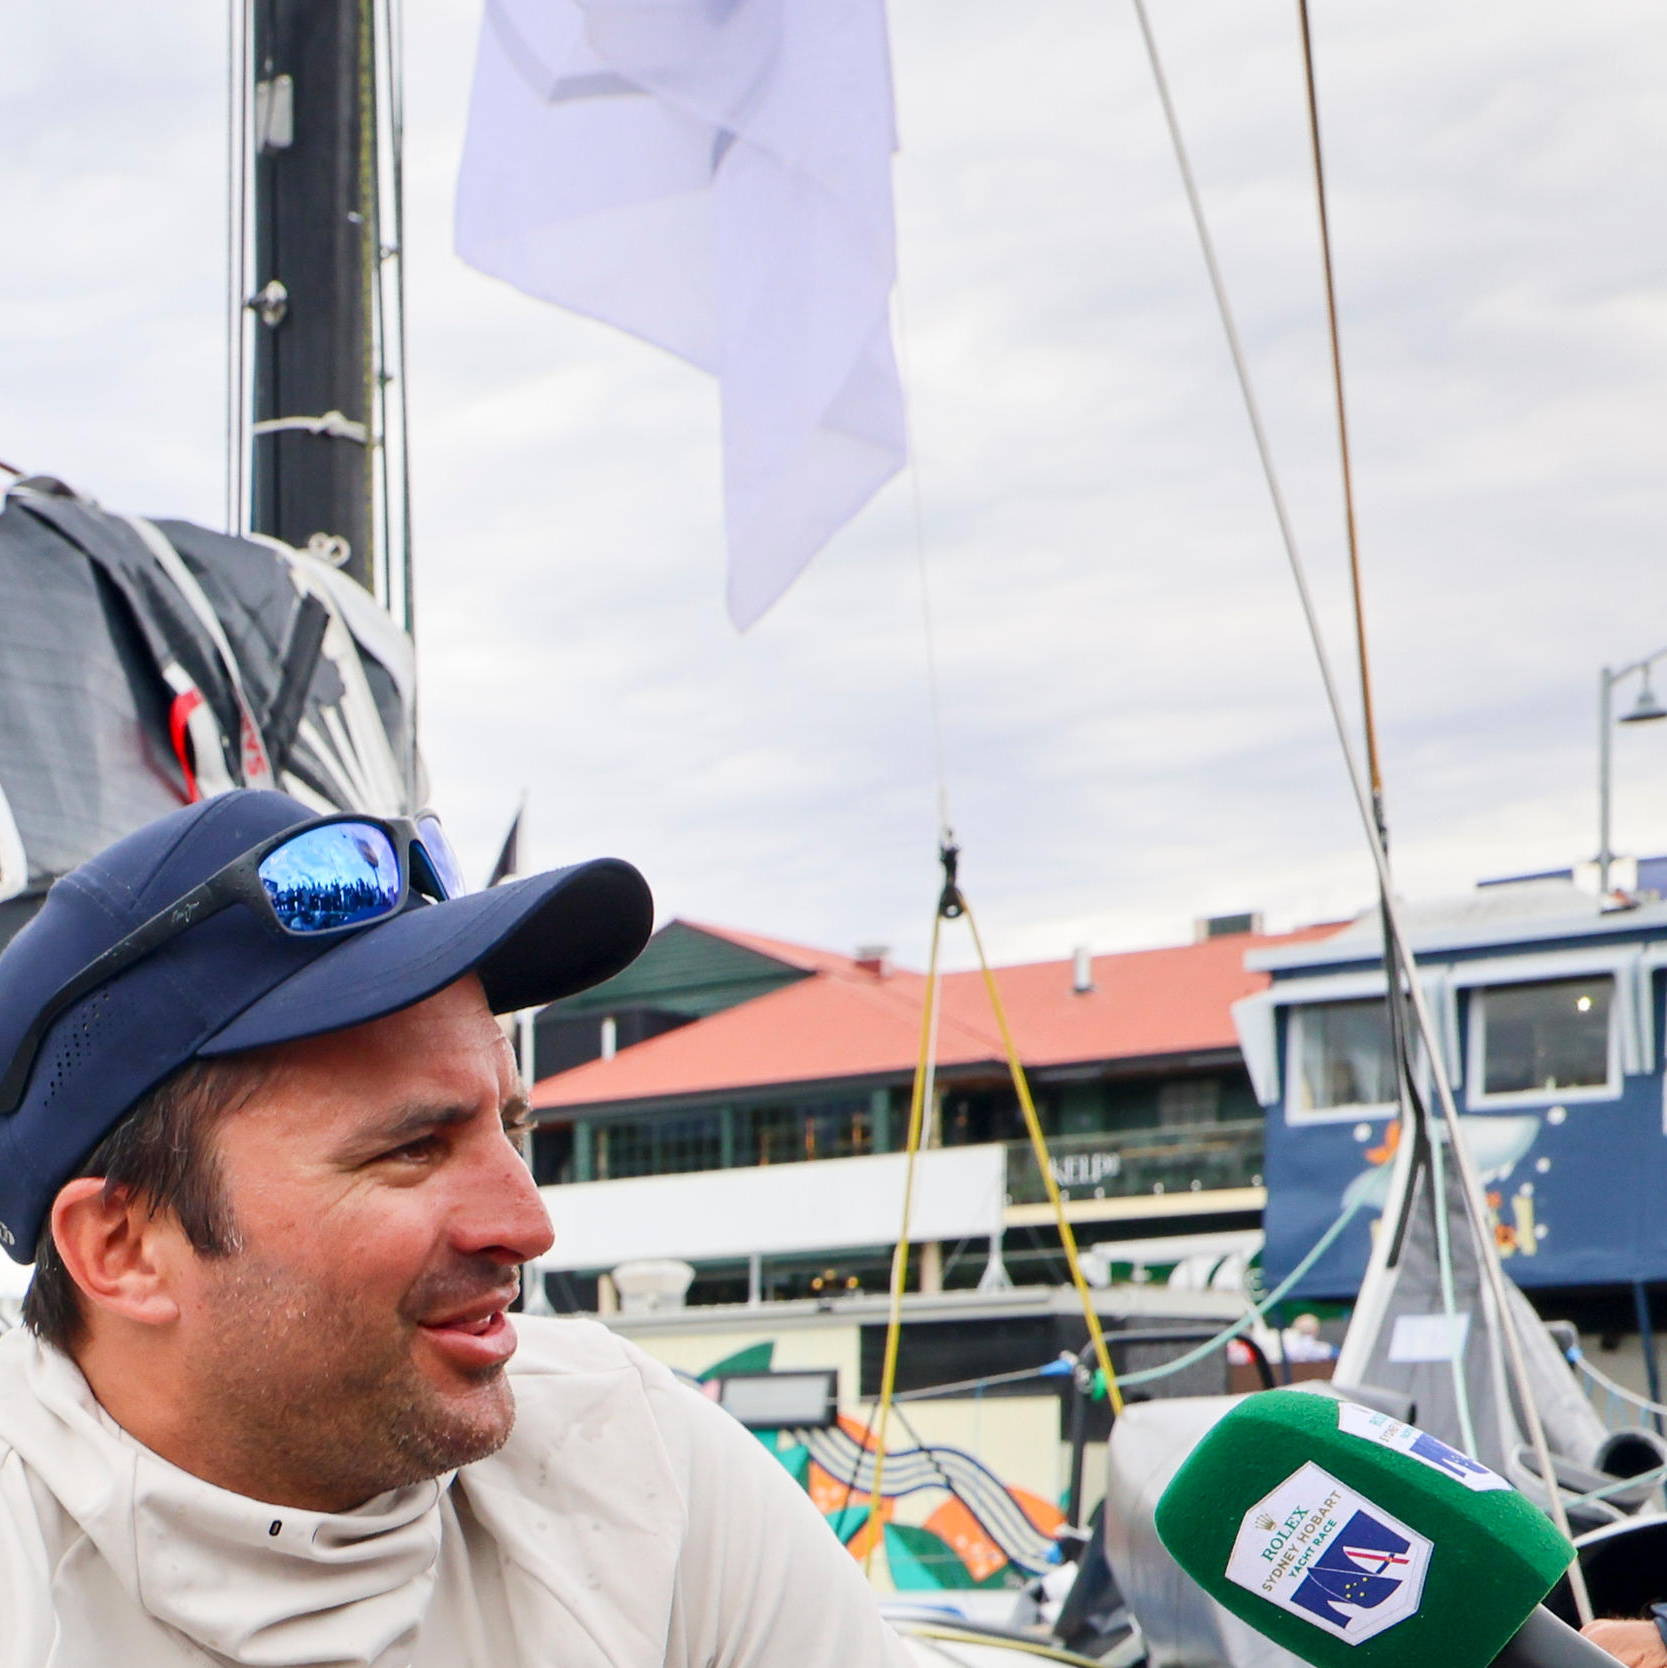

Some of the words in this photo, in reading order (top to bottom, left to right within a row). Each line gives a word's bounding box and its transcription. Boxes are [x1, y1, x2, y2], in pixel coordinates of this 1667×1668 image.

[1261, 1505, 1309, 1562] ROLEX
[1262, 1544, 1299, 1591] SYDNEY
[1297, 1490, 1342, 1544] HOBART
[1288, 1546, 1316, 1578] YACHT
[1313, 1519, 1337, 1546] RACE
